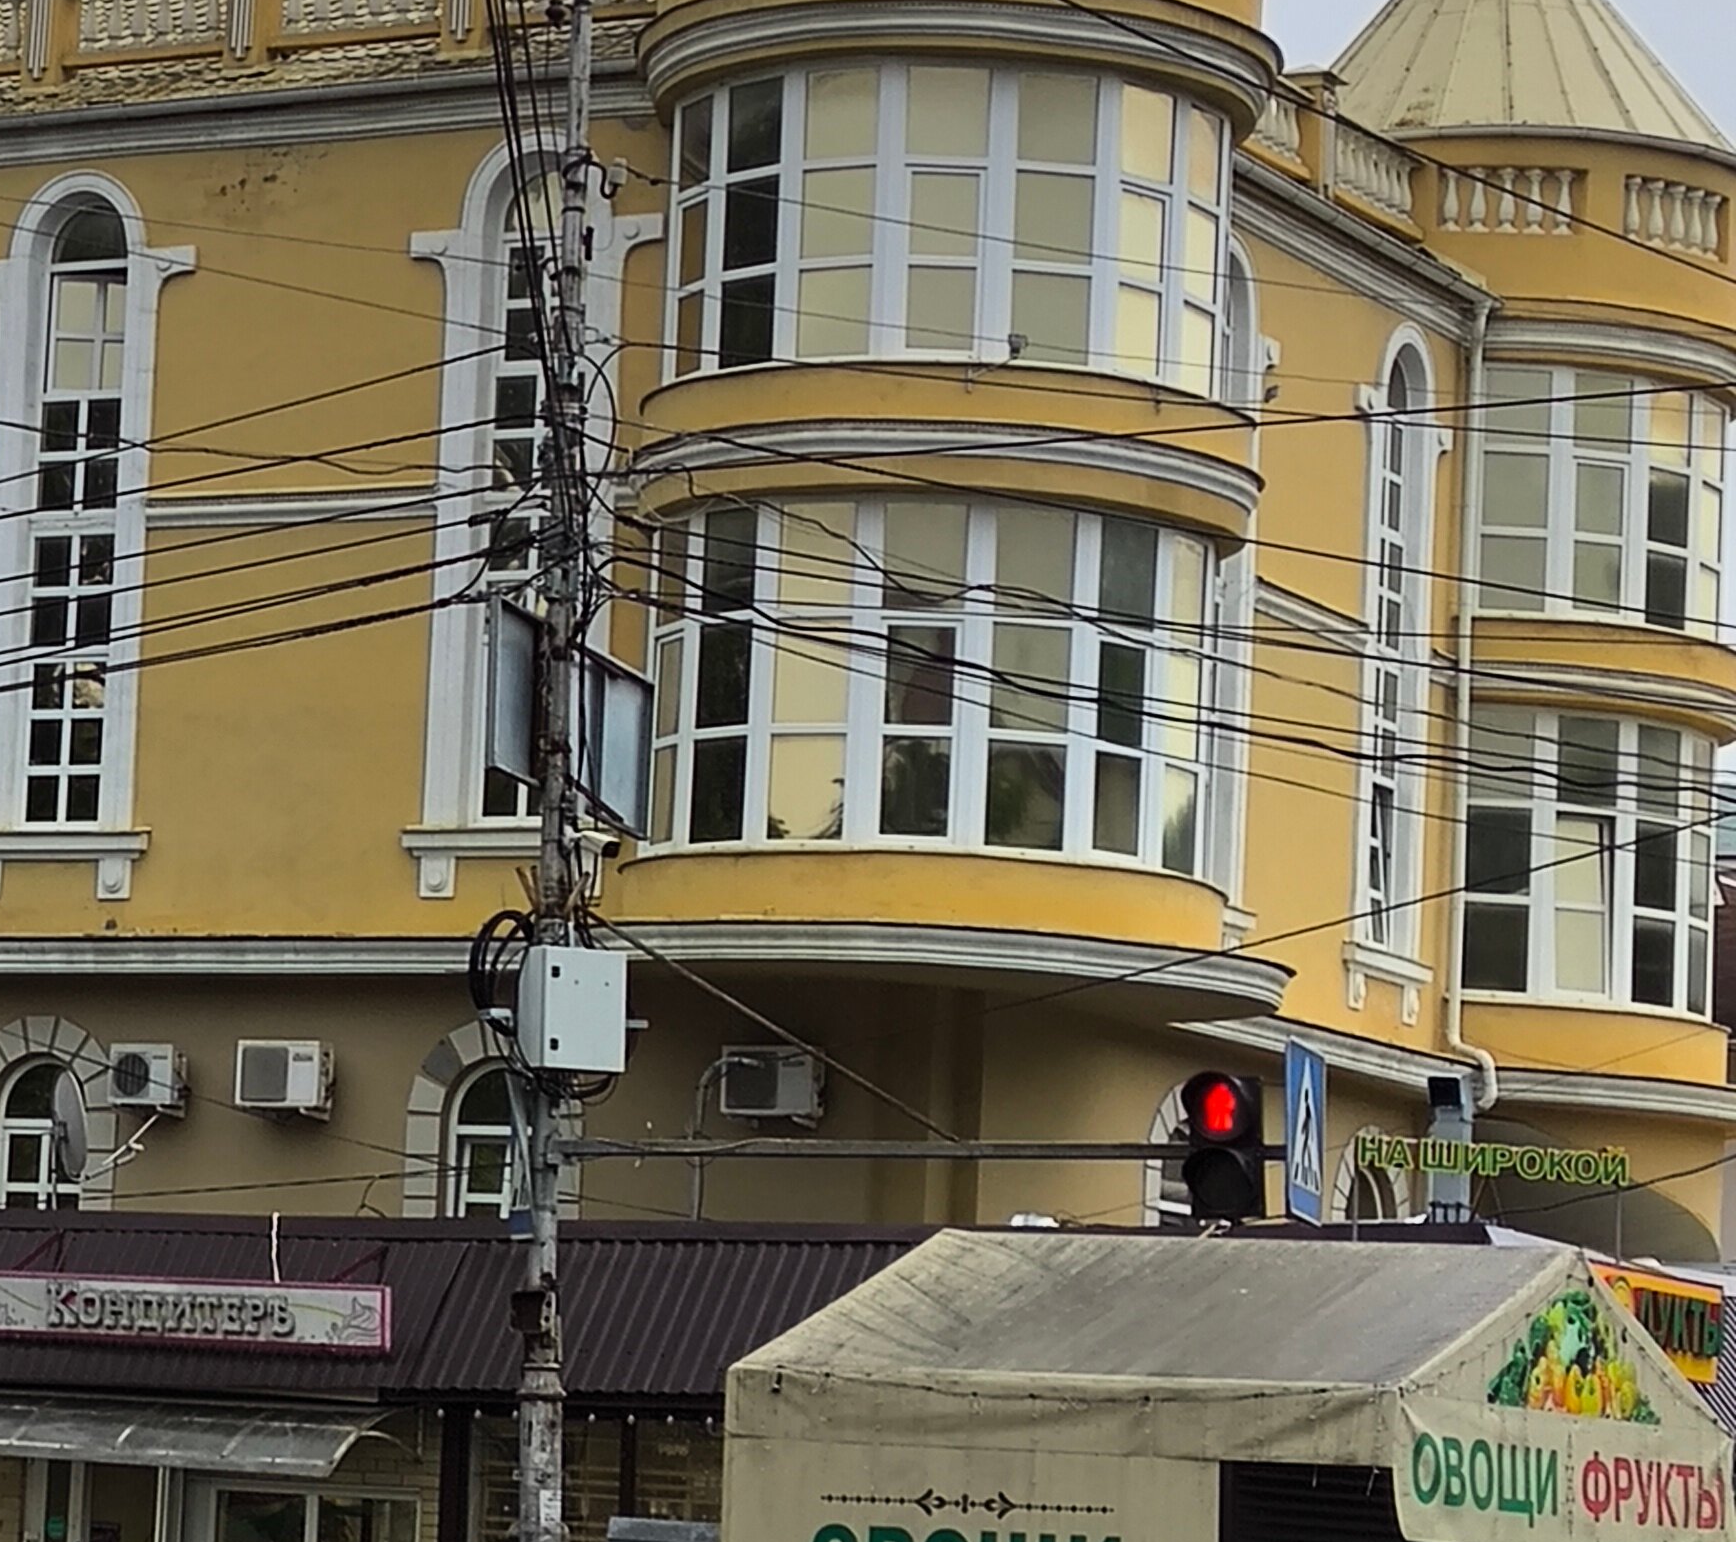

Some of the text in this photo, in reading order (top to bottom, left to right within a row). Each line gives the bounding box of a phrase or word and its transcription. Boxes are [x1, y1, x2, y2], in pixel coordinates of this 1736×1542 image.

[1357, 1136, 1630, 1186] НА ШИРОКОЙ
[1412, 1432, 1725, 1530] ОВОЩИ ФРУКТЫ
